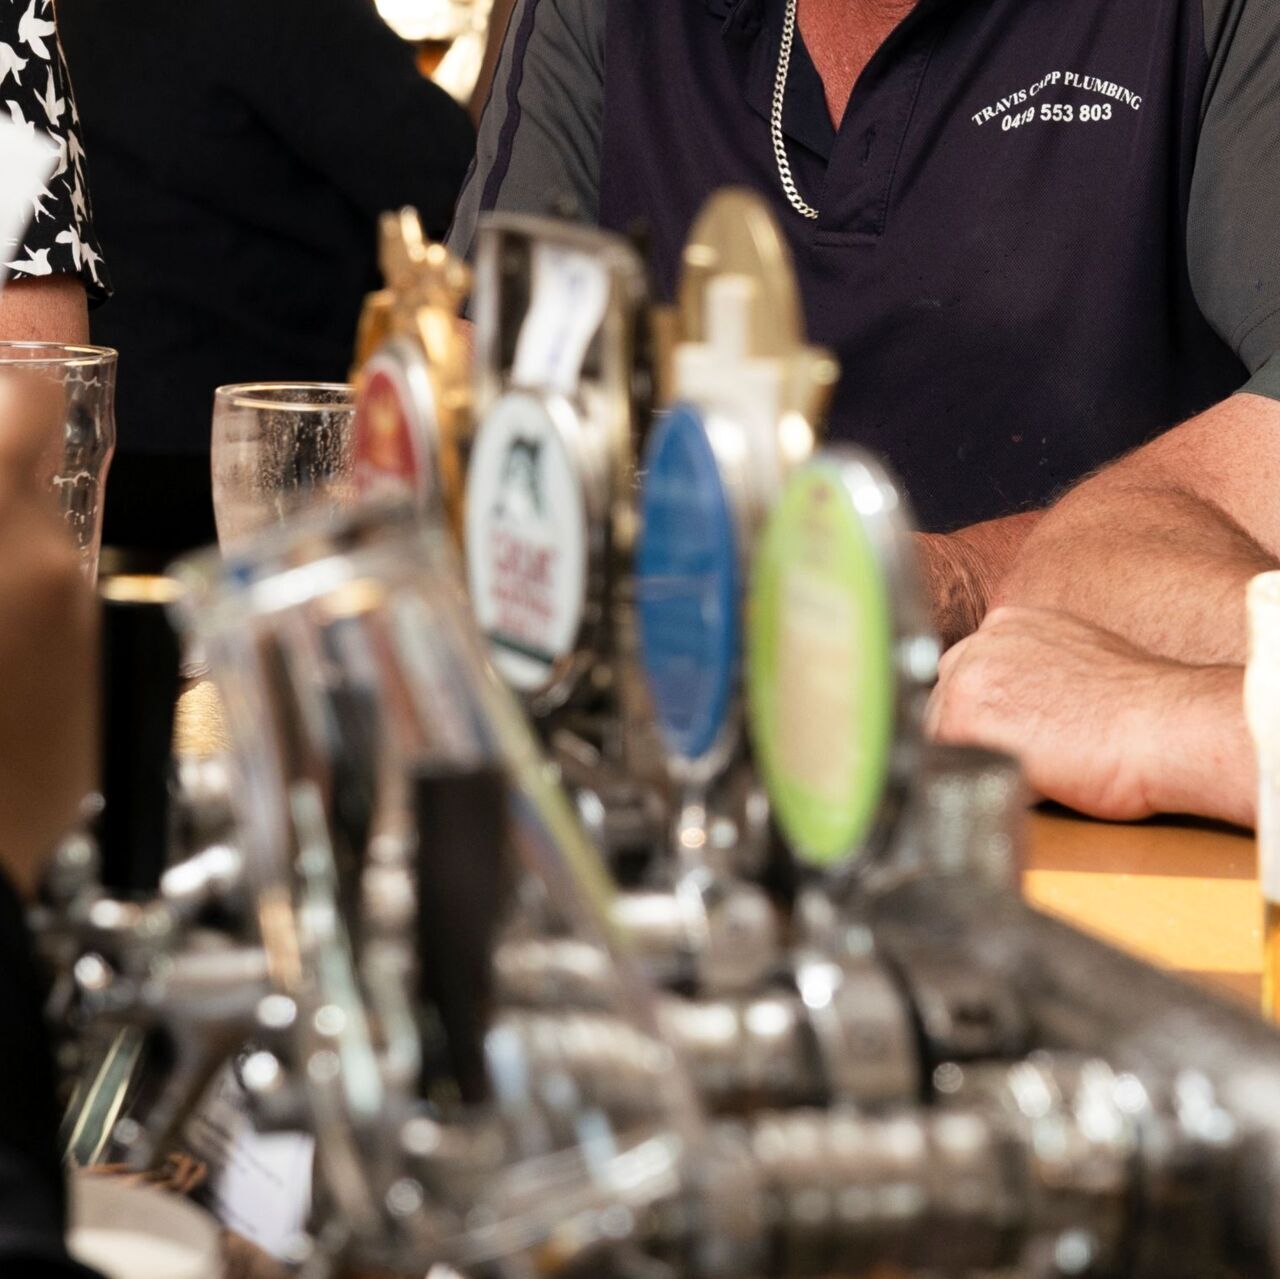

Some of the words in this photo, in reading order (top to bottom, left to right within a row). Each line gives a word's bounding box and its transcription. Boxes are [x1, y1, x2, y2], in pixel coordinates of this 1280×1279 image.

[971, 89, 1027, 126] TRAVIS
[1029, 71, 1061, 96] CAPP
[1063, 71, 1143, 110] PLUMBING
[1001, 107, 1035, 131] 0419
[1039, 103, 1074, 122] 553
[1078, 103, 1113, 122] 803
